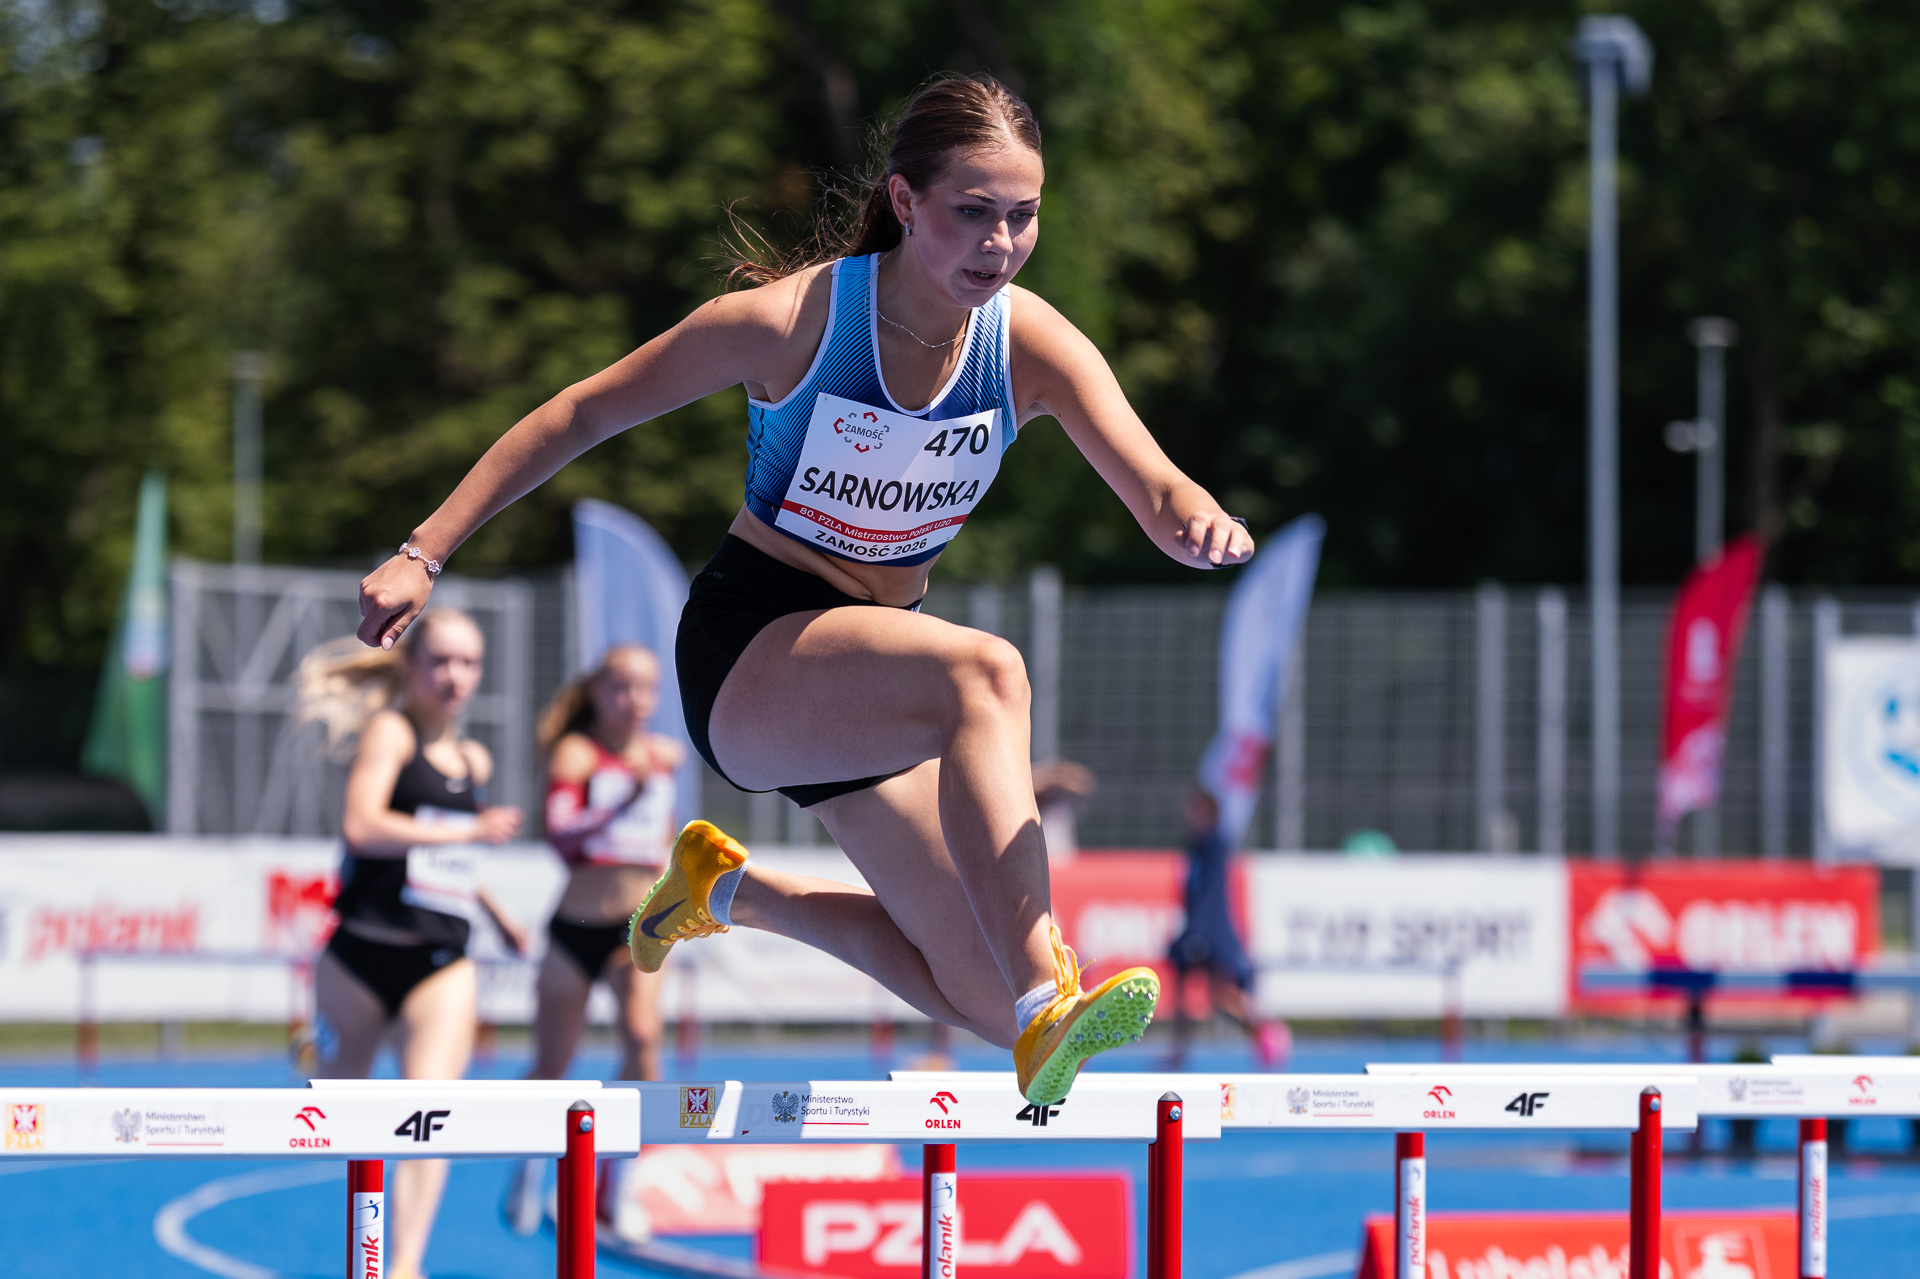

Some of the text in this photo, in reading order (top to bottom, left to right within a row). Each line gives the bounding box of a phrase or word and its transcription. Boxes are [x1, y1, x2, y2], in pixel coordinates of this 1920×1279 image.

[844, 423, 884, 441] ZAMOŚĆ
[924, 423, 989, 457] 470
[799, 466, 980, 513] SARNOWSKA
[799, 507, 952, 542] 80. PZLA Mistrzostwa Polski U20
[815, 530, 928, 557] ZAMOŚĆ 2026
[1680, 901, 1857, 971] ORLEN
[801, 1095, 853, 1104] Ministerstwo
[801, 1106, 827, 1117] Sportu
[835, 1106, 870, 1117] Turystyki
[1505, 1092, 1550, 1117] 4F
[145, 1112, 205, 1122] Ministerstwo
[394, 1110, 451, 1142] 4F
[681, 1116, 712, 1127] PZLA
[925, 1120, 961, 1129] ORLEN
[1423, 1110, 1455, 1119] ORLEN
[145, 1125, 175, 1136] Sportu
[183, 1125, 225, 1136] Turystyki
[289, 1138, 331, 1148] ORLEN
[802, 1200, 1084, 1267] PZLA
[1410, 1196, 1422, 1266] polanik
[361, 1235, 379, 1279] anik
[937, 1214, 953, 1279] olanik
